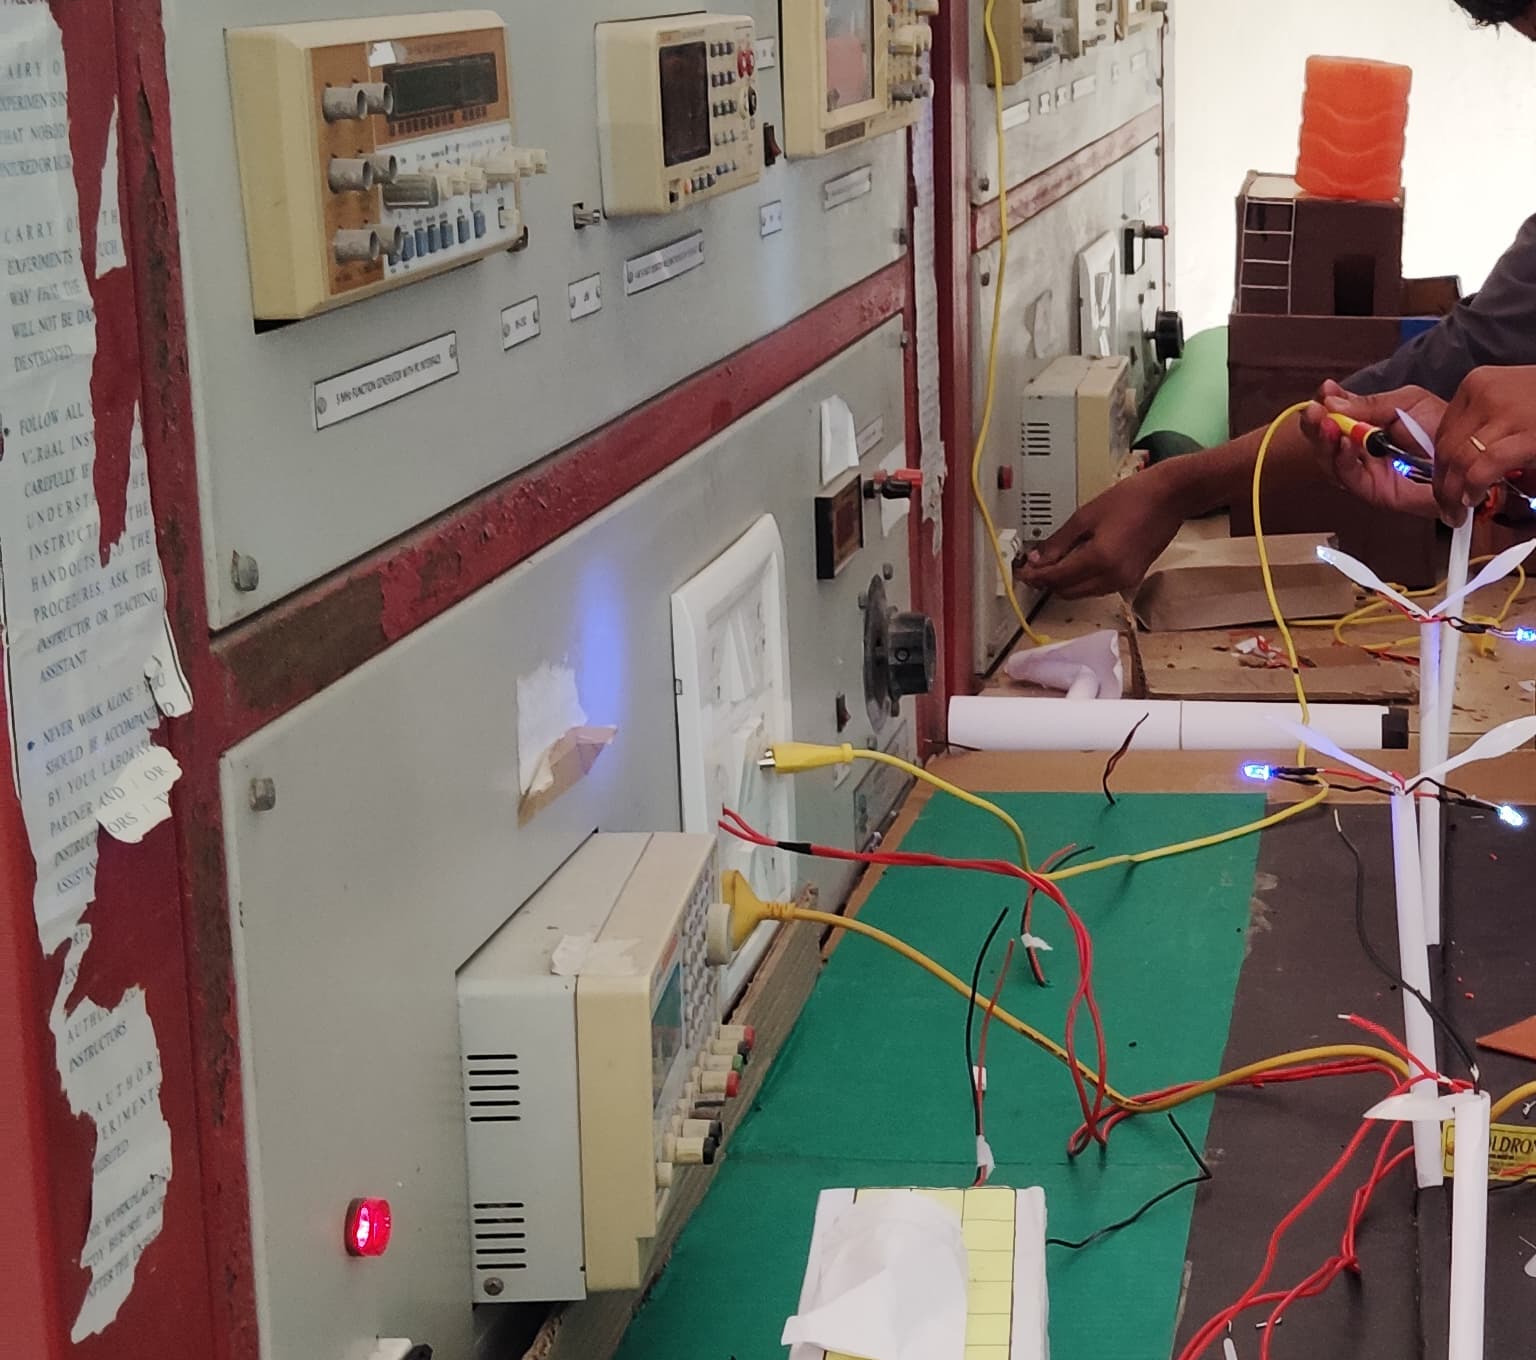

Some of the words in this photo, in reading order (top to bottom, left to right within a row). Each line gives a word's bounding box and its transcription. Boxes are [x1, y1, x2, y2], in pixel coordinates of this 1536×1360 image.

[38, 314, 58, 332] NOT
[61, 311, 73, 329] BE
[20, 408, 59, 437] FOLLOW
[65, 402, 84, 423] ALL
[96, 607, 110, 628] OR
